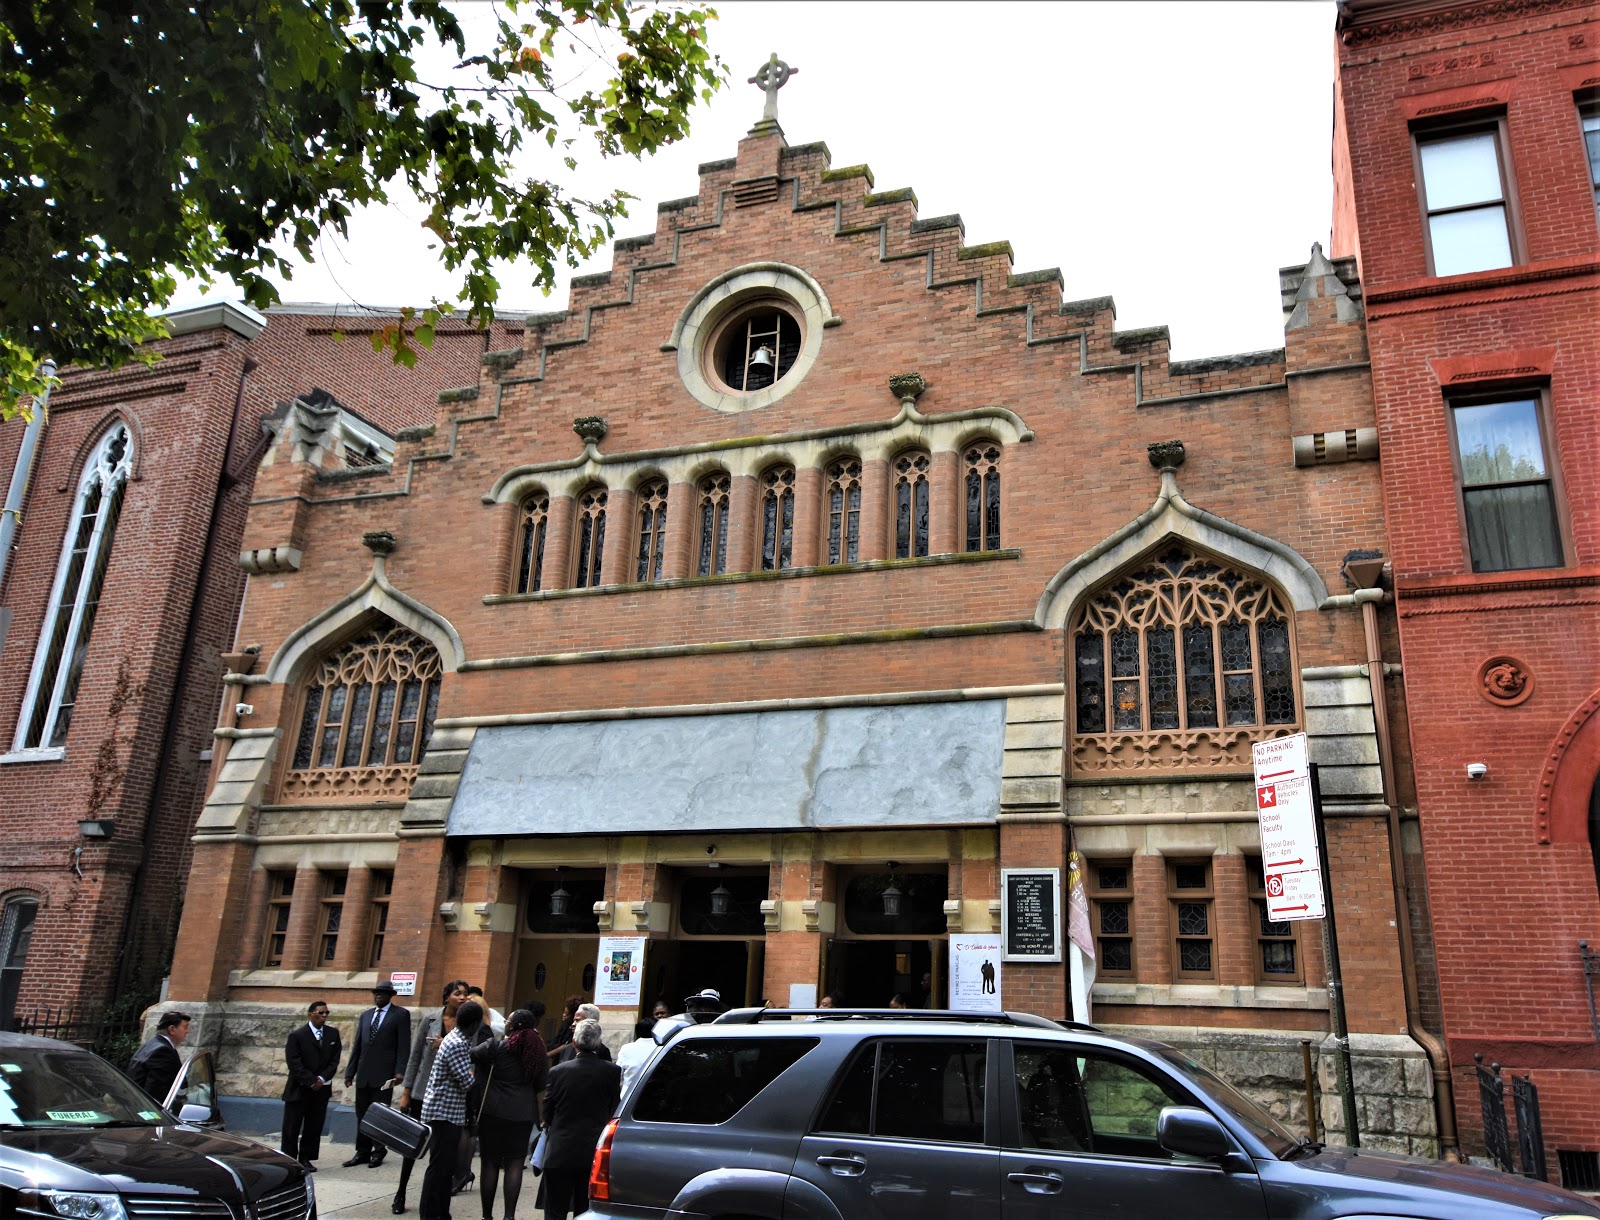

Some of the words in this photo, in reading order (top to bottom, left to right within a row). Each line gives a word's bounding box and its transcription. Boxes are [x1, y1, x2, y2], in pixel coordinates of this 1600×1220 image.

[1256, 747, 1264, 756] NO
[1266, 741, 1294, 754] PARKING
[1258, 754, 1282, 766] Anytime
[1276, 780, 1304, 791] Authorized
[1278, 789, 1298, 798] Vehicles
[1262, 814, 1280, 822] School
[1263, 824, 1282, 832] Faculty
[1265, 840, 1282, 850] School
[52, 1112, 94, 1120] FUNERAL
